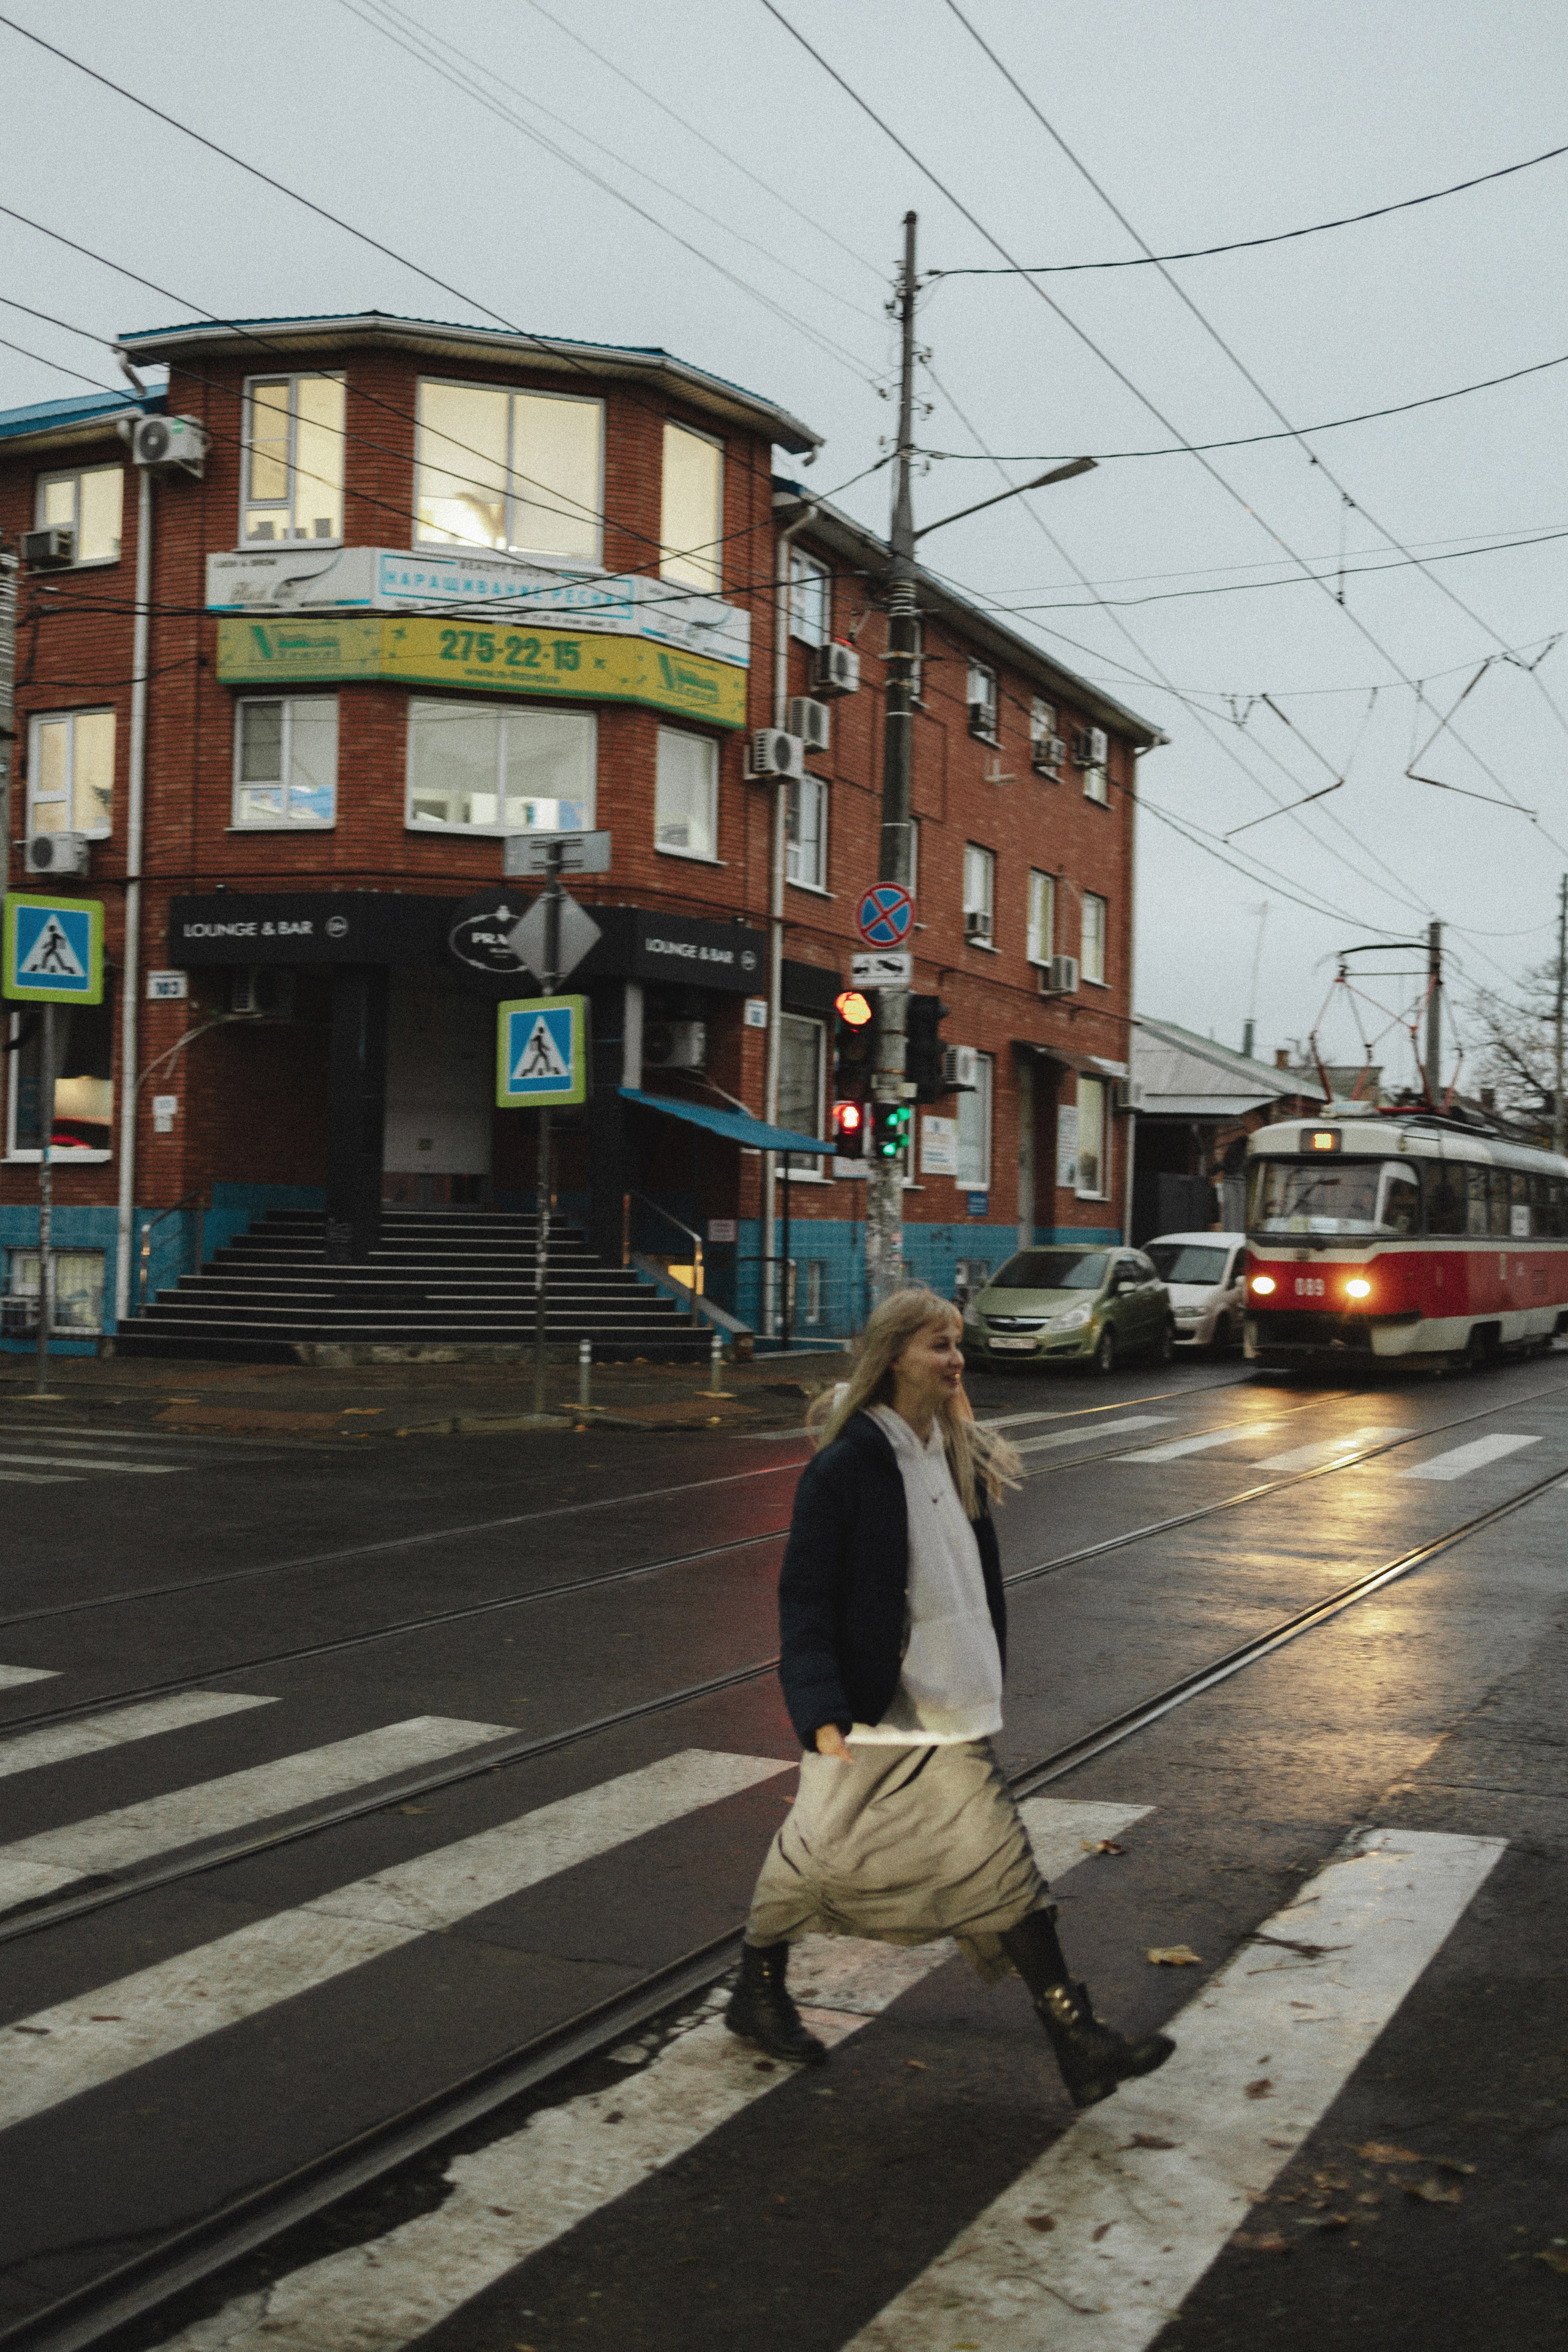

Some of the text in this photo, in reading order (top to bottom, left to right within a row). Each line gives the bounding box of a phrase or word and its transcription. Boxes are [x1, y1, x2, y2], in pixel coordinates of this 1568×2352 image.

[183, 922, 258, 937] LOUNGE
[261, 921, 276, 936] &
[277, 920, 314, 935] BAR
[645, 938, 697, 959] LOUNGE
